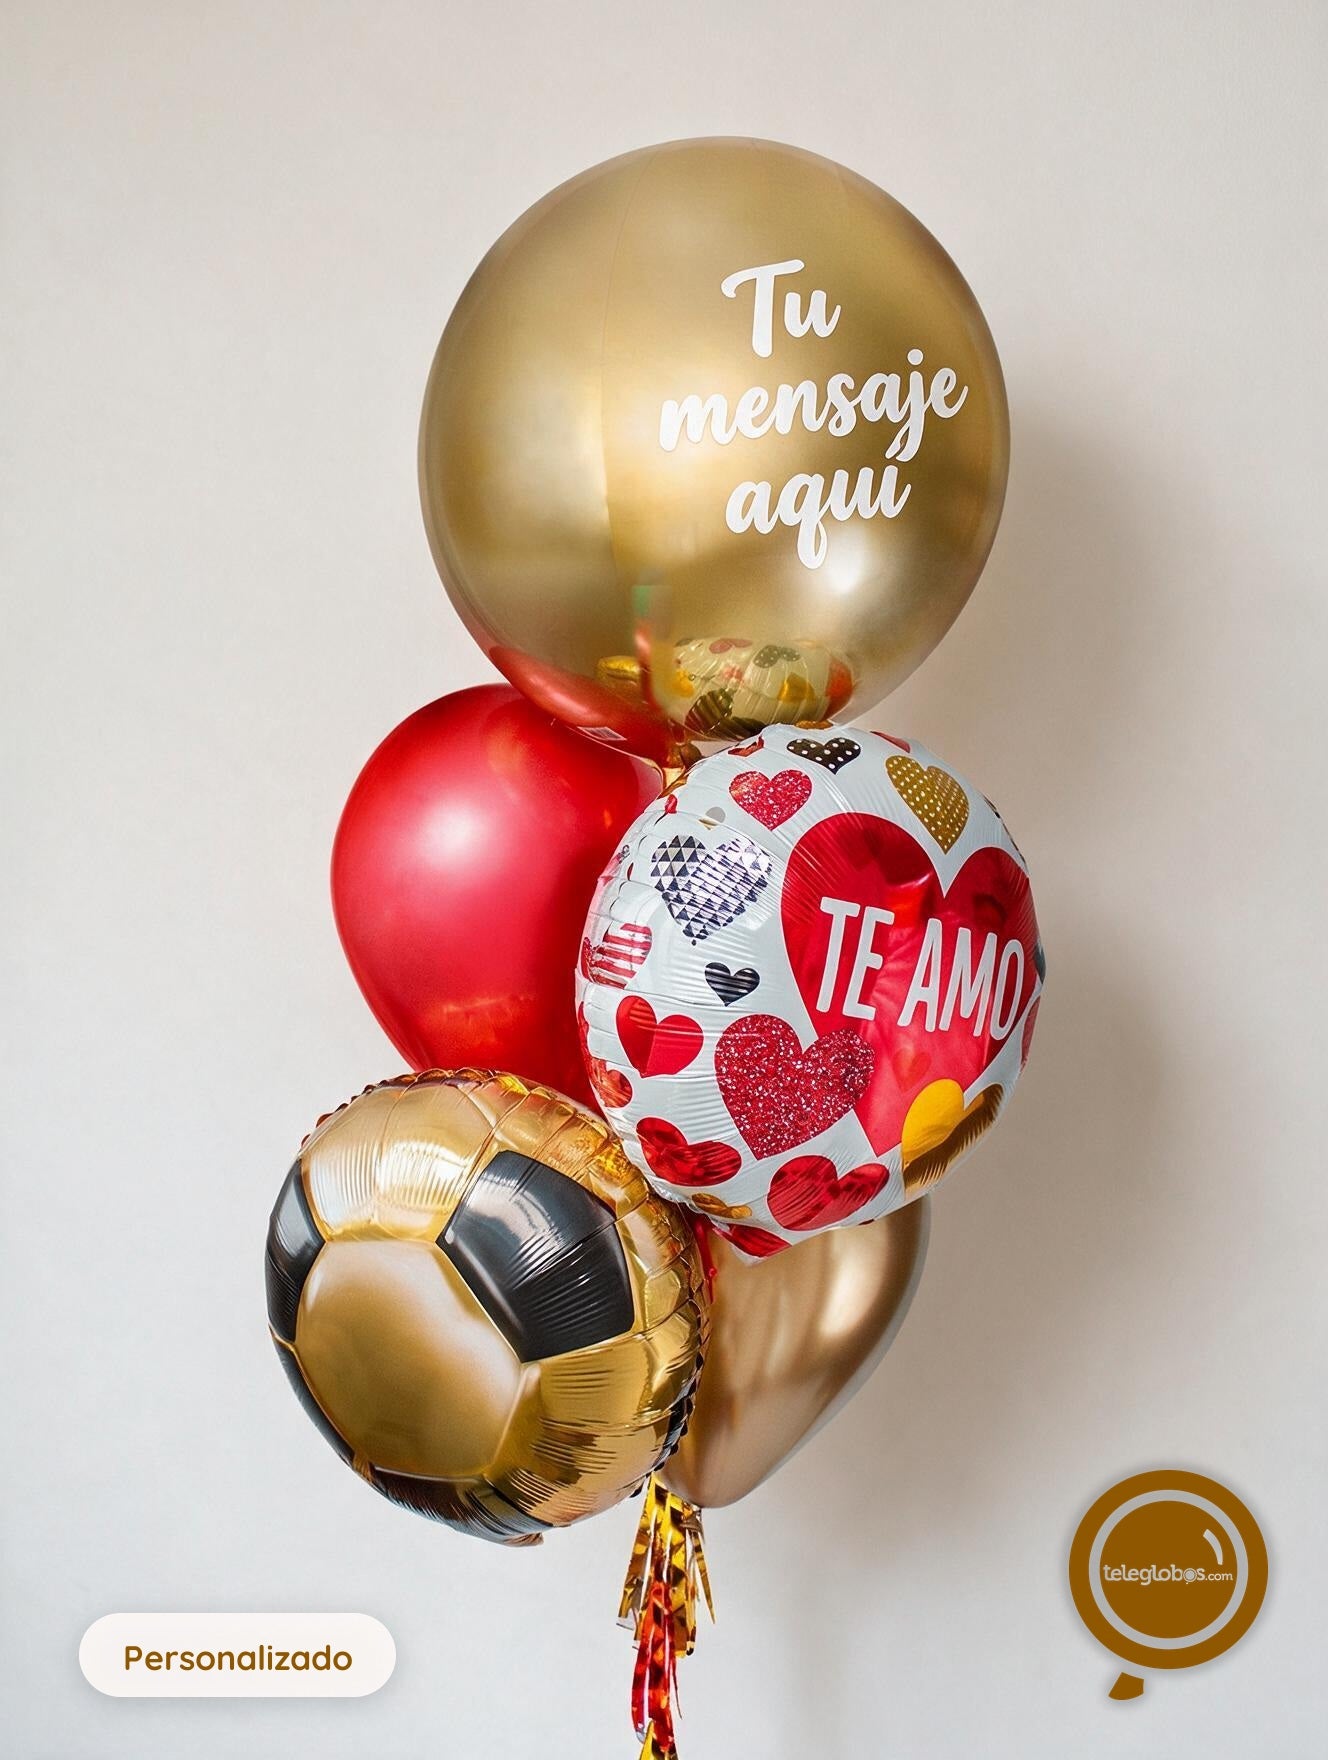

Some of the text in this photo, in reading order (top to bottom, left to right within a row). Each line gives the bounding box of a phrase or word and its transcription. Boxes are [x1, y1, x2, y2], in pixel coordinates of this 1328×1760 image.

[721, 259, 841, 358] Tu
[659, 349, 968, 462] mensaje
[815, 896, 1025, 1041] TE AMO
